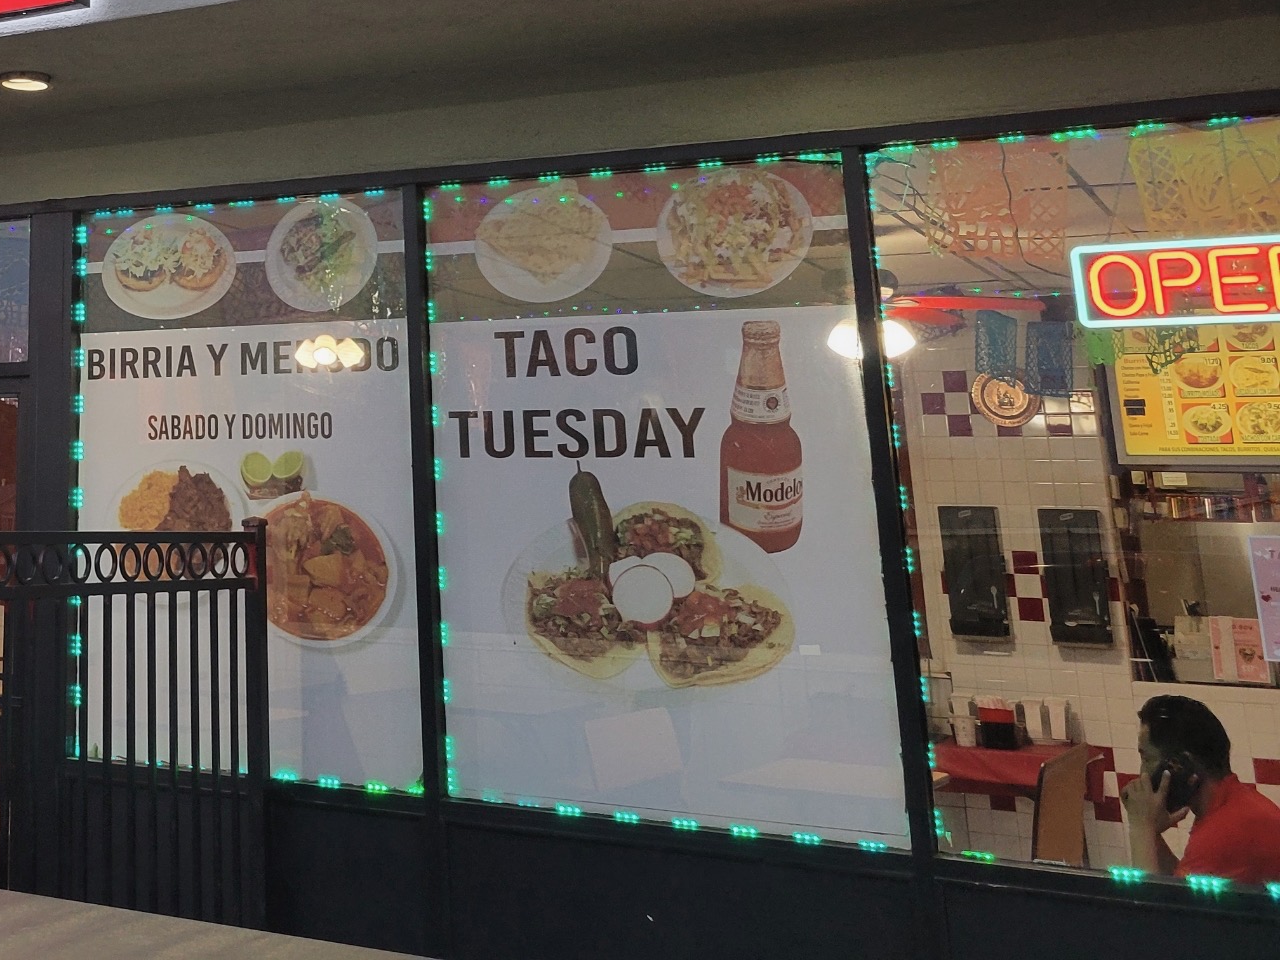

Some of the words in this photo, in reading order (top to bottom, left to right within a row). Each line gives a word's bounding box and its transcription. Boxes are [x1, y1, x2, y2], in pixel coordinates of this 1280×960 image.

[1088, 244, 1280, 318] OPE
[86, 345, 197, 381] BIRRIA
[206, 343, 229, 376] Y
[493, 326, 639, 378] TACO
[147, 413, 219, 441] SABADO
[224, 413, 237, 440] Y
[242, 411, 333, 440] DOMINGO
[448, 407, 705, 459] TUESDAY
[745, 477, 803, 502] Modelo
